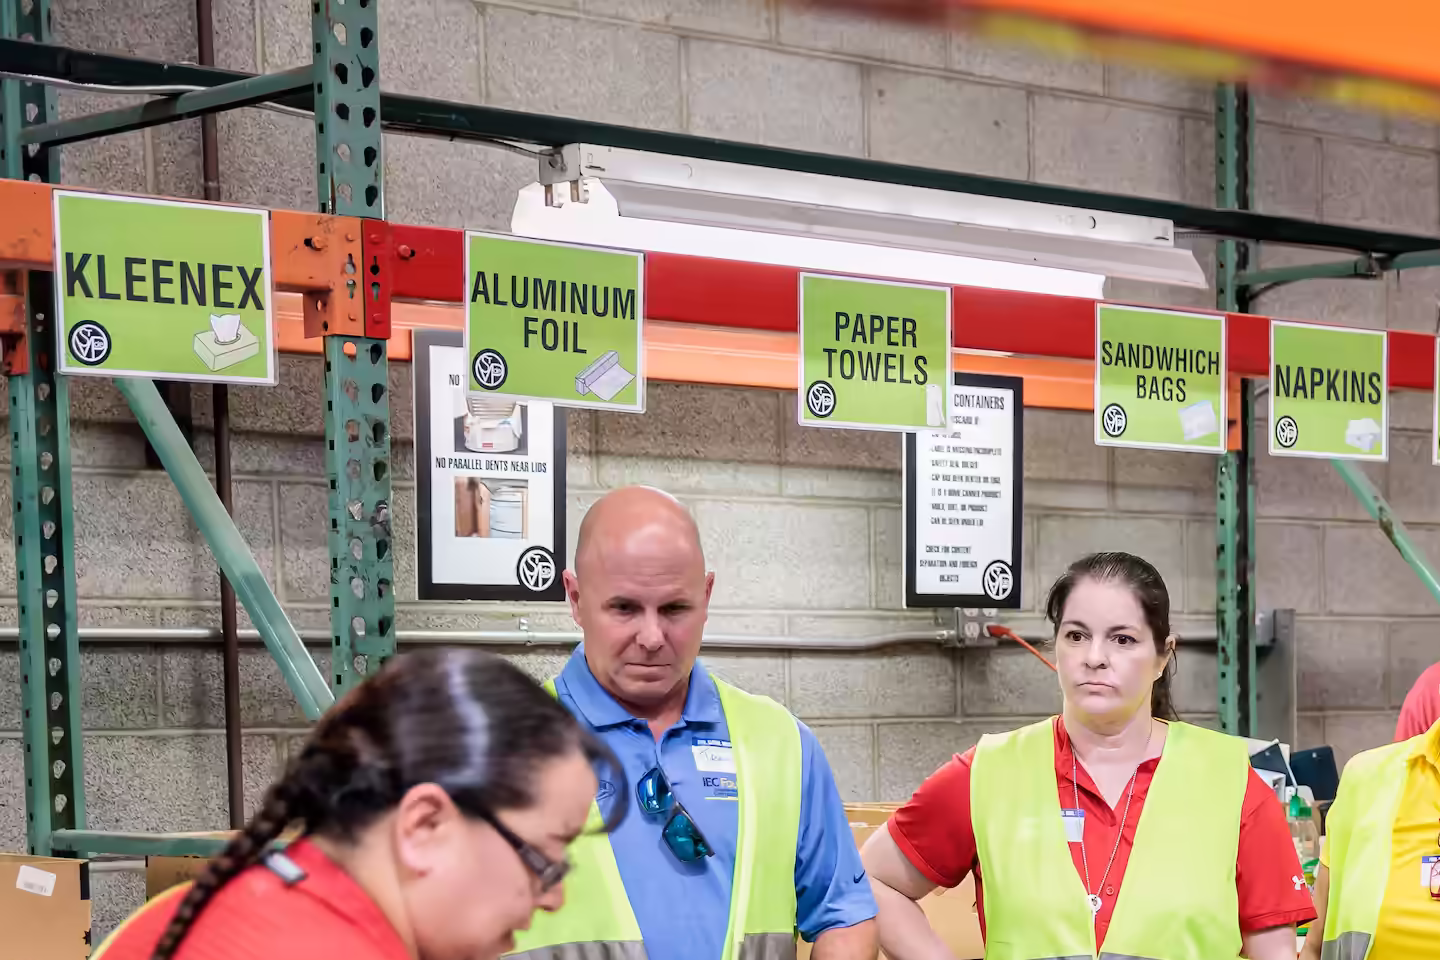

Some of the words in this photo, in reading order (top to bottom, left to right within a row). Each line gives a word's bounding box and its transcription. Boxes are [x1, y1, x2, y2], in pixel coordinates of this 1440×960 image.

[65, 252, 264, 310] KLEENEX
[471, 271, 635, 320] ALUMINUM
[524, 316, 587, 354] FOIL
[835, 311, 917, 348] PAPER
[823, 348, 928, 385] TOWELS
[1102, 340, 1219, 375] SANDWHICH
[954, 393, 1005, 410] CONTAINERS
[1136, 375, 1186, 402] BAGS
[1275, 364, 1381, 404] NAPKINS
[435, 456, 446, 469] NO
[448, 457, 483, 471] PARALLEL
[485, 459, 508, 472] DENTS
[511, 460, 529, 473] NEAR
[531, 461, 547, 474] LIDS
[702, 776, 720, 787] IEC
